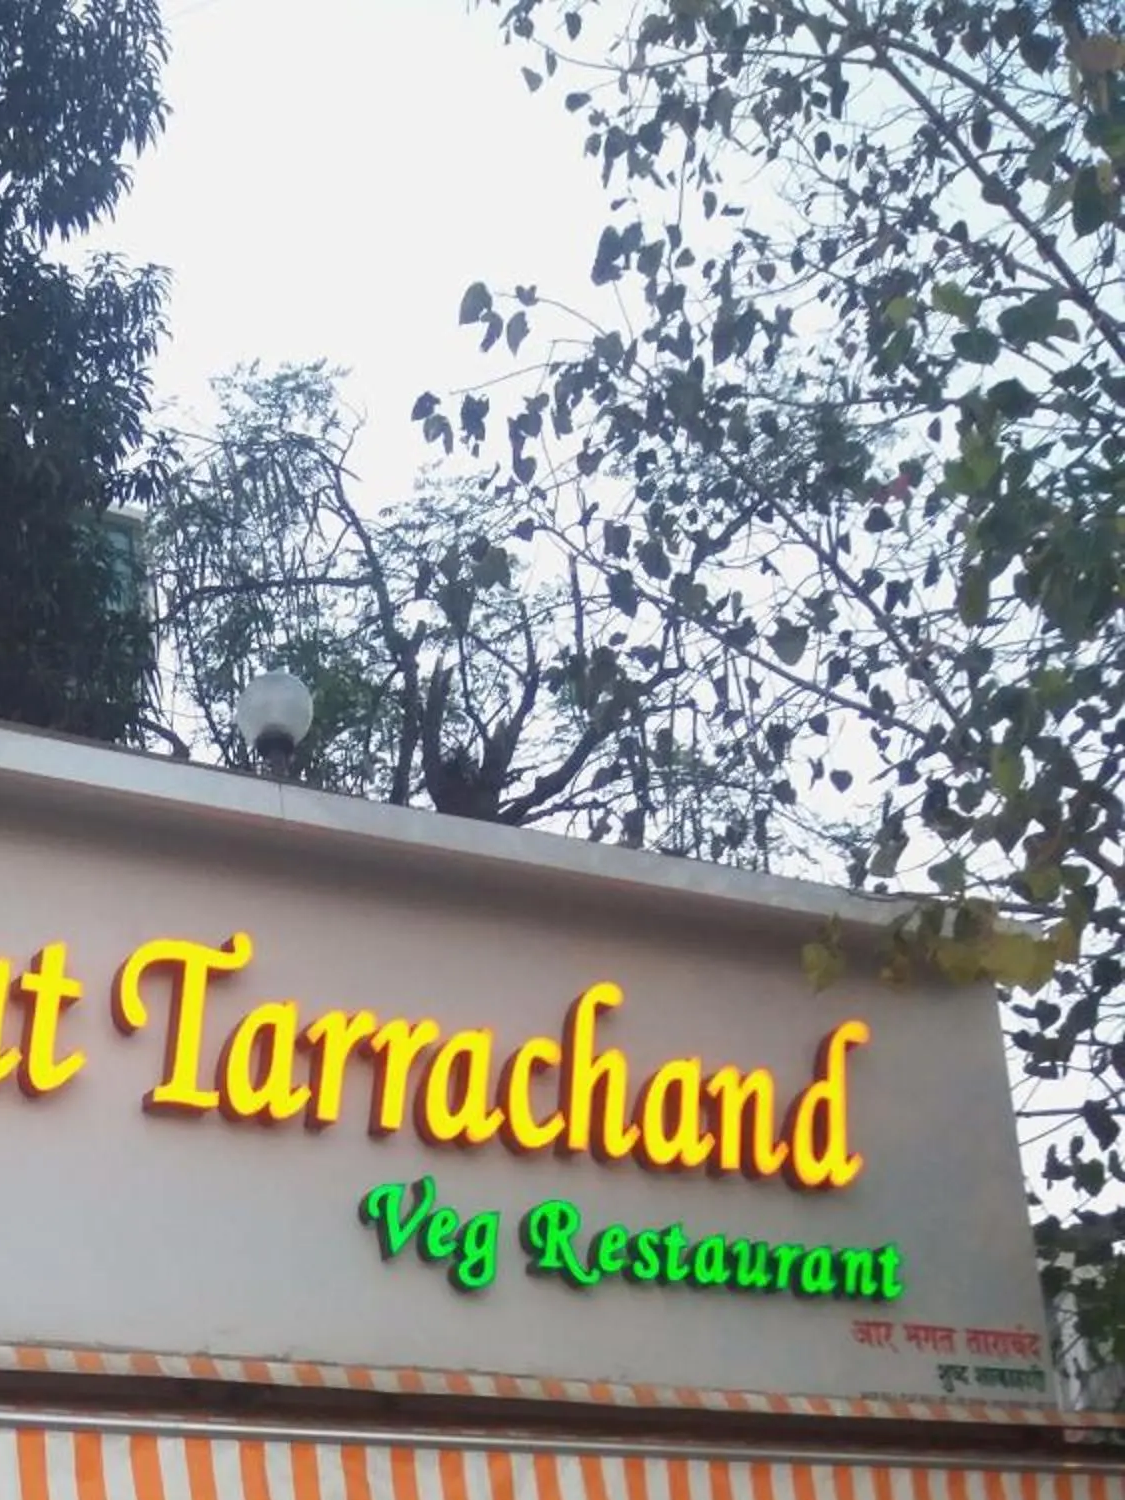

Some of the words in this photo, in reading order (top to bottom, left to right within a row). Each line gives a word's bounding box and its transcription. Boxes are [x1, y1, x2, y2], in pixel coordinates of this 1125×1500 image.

[113, 931, 871, 1191] Tarrachand
[362, 1174, 502, 1291] Veg
[523, 1198, 906, 1303] Restaurant
